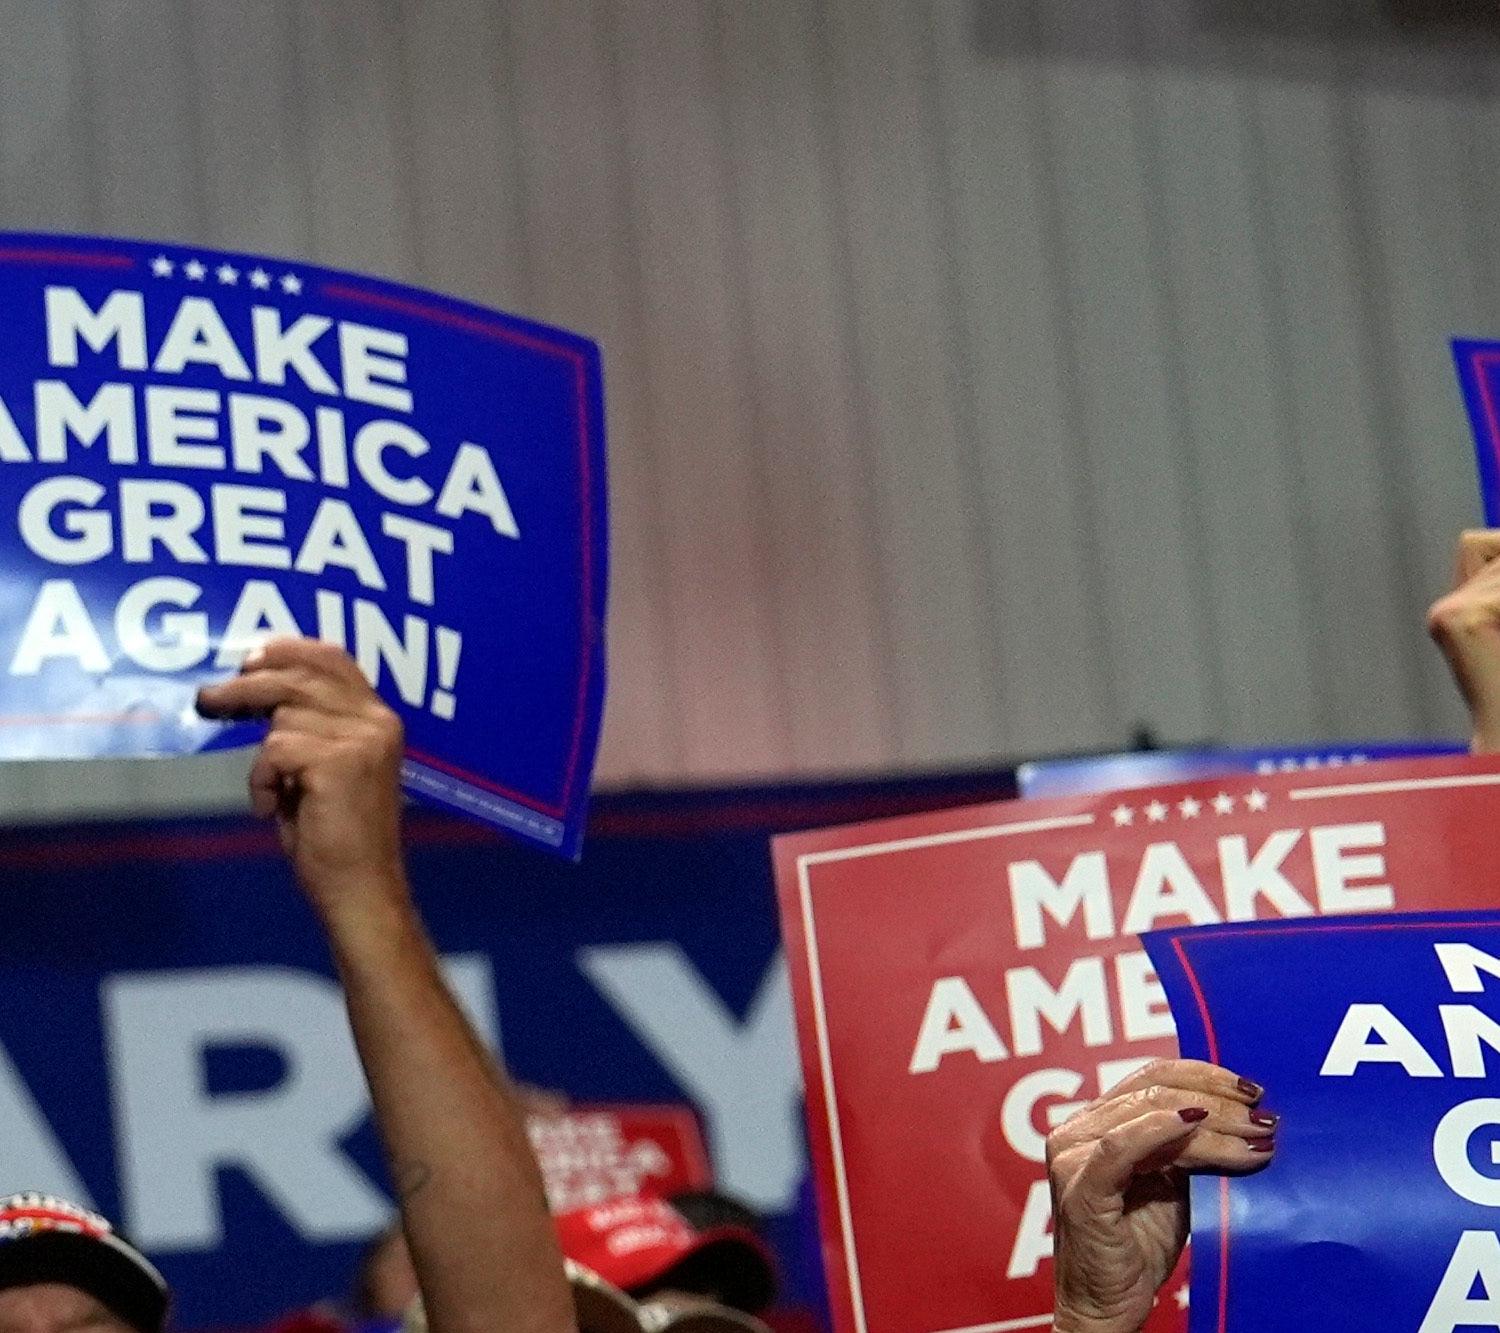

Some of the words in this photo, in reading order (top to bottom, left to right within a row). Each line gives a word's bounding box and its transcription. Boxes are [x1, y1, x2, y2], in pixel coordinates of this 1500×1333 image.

[44, 286, 413, 411] MAKE
[17, 476, 454, 605] GREAT
[1006, 821, 1395, 952] MAKE
